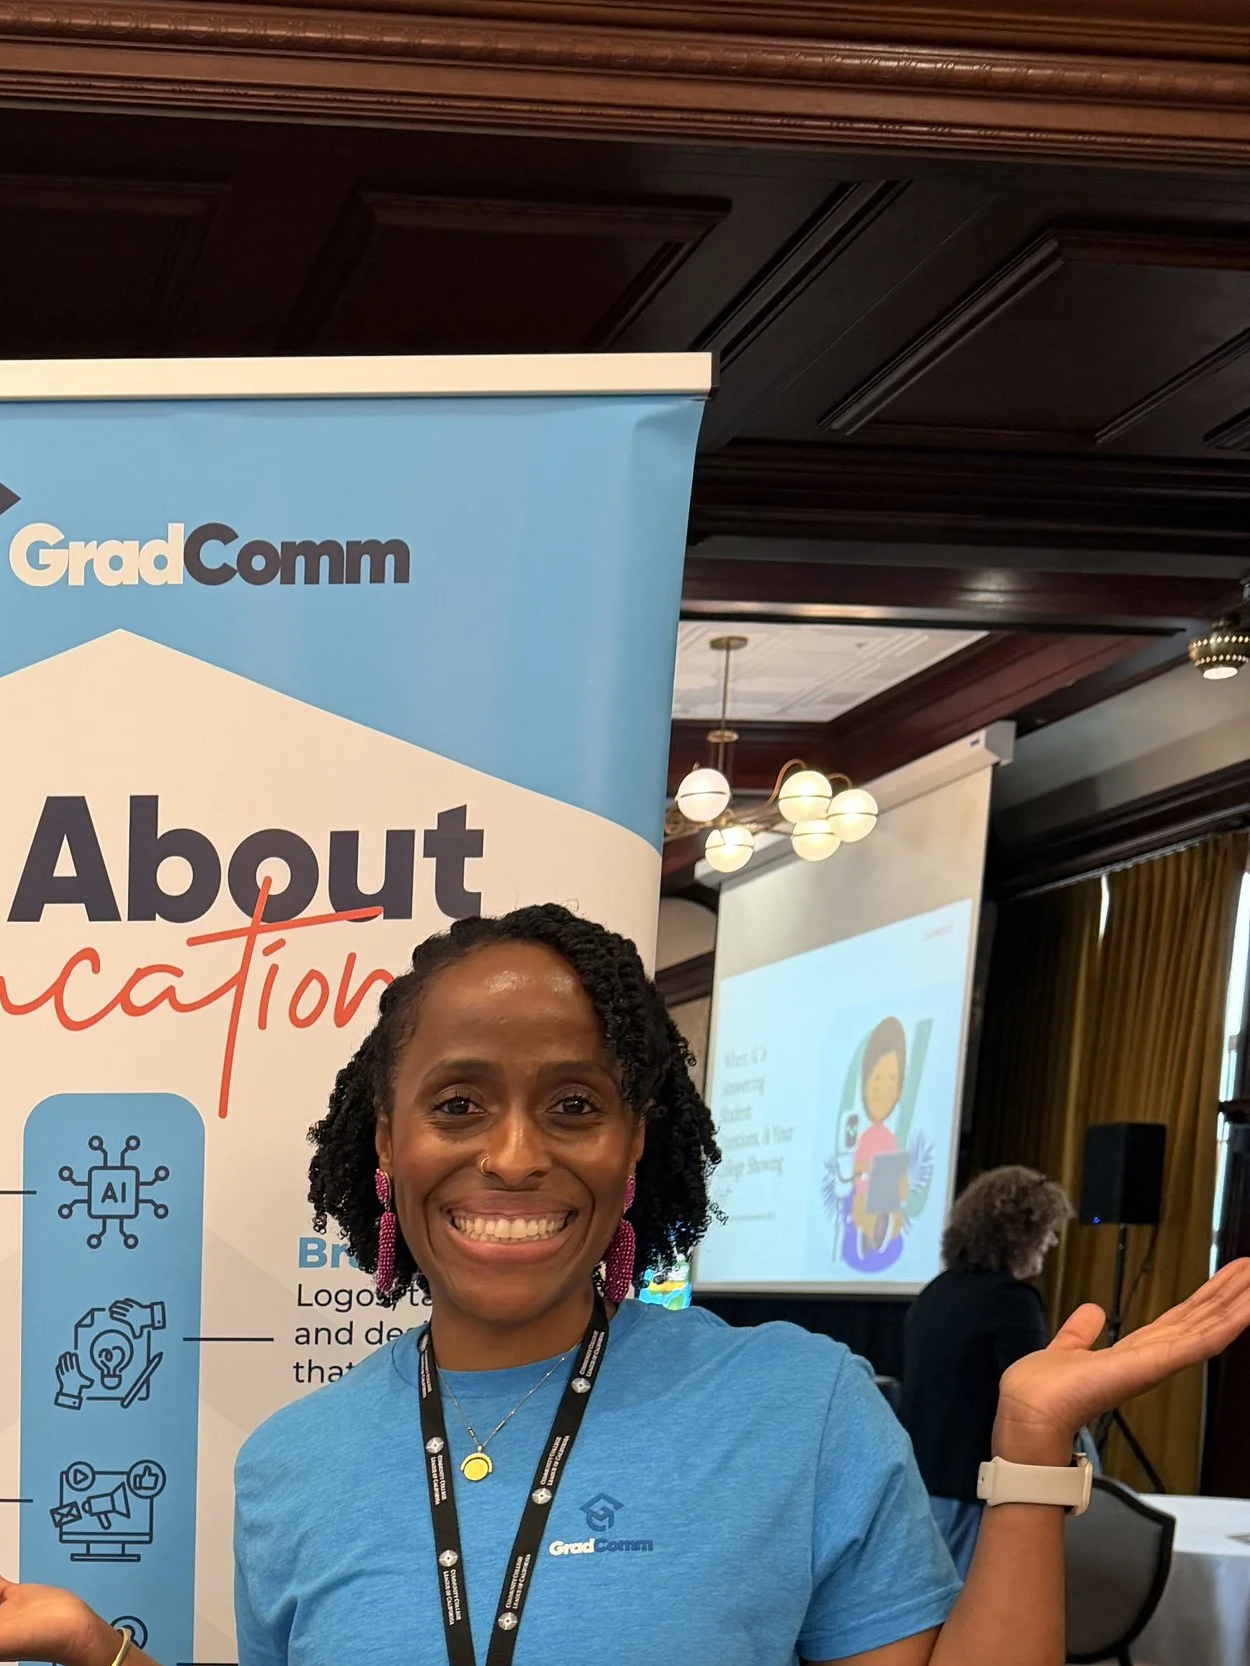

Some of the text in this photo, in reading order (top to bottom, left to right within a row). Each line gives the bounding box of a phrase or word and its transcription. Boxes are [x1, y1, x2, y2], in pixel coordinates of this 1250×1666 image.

[9, 522, 411, 588] GradComm
[7, 794, 484, 924] About
[100, 1186, 127, 1204] AI
[298, 1236, 361, 1269] Br
[297, 1283, 398, 1313] Logo,
[294, 1320, 354, 1346] and
[549, 1536, 654, 1556] GradComm
